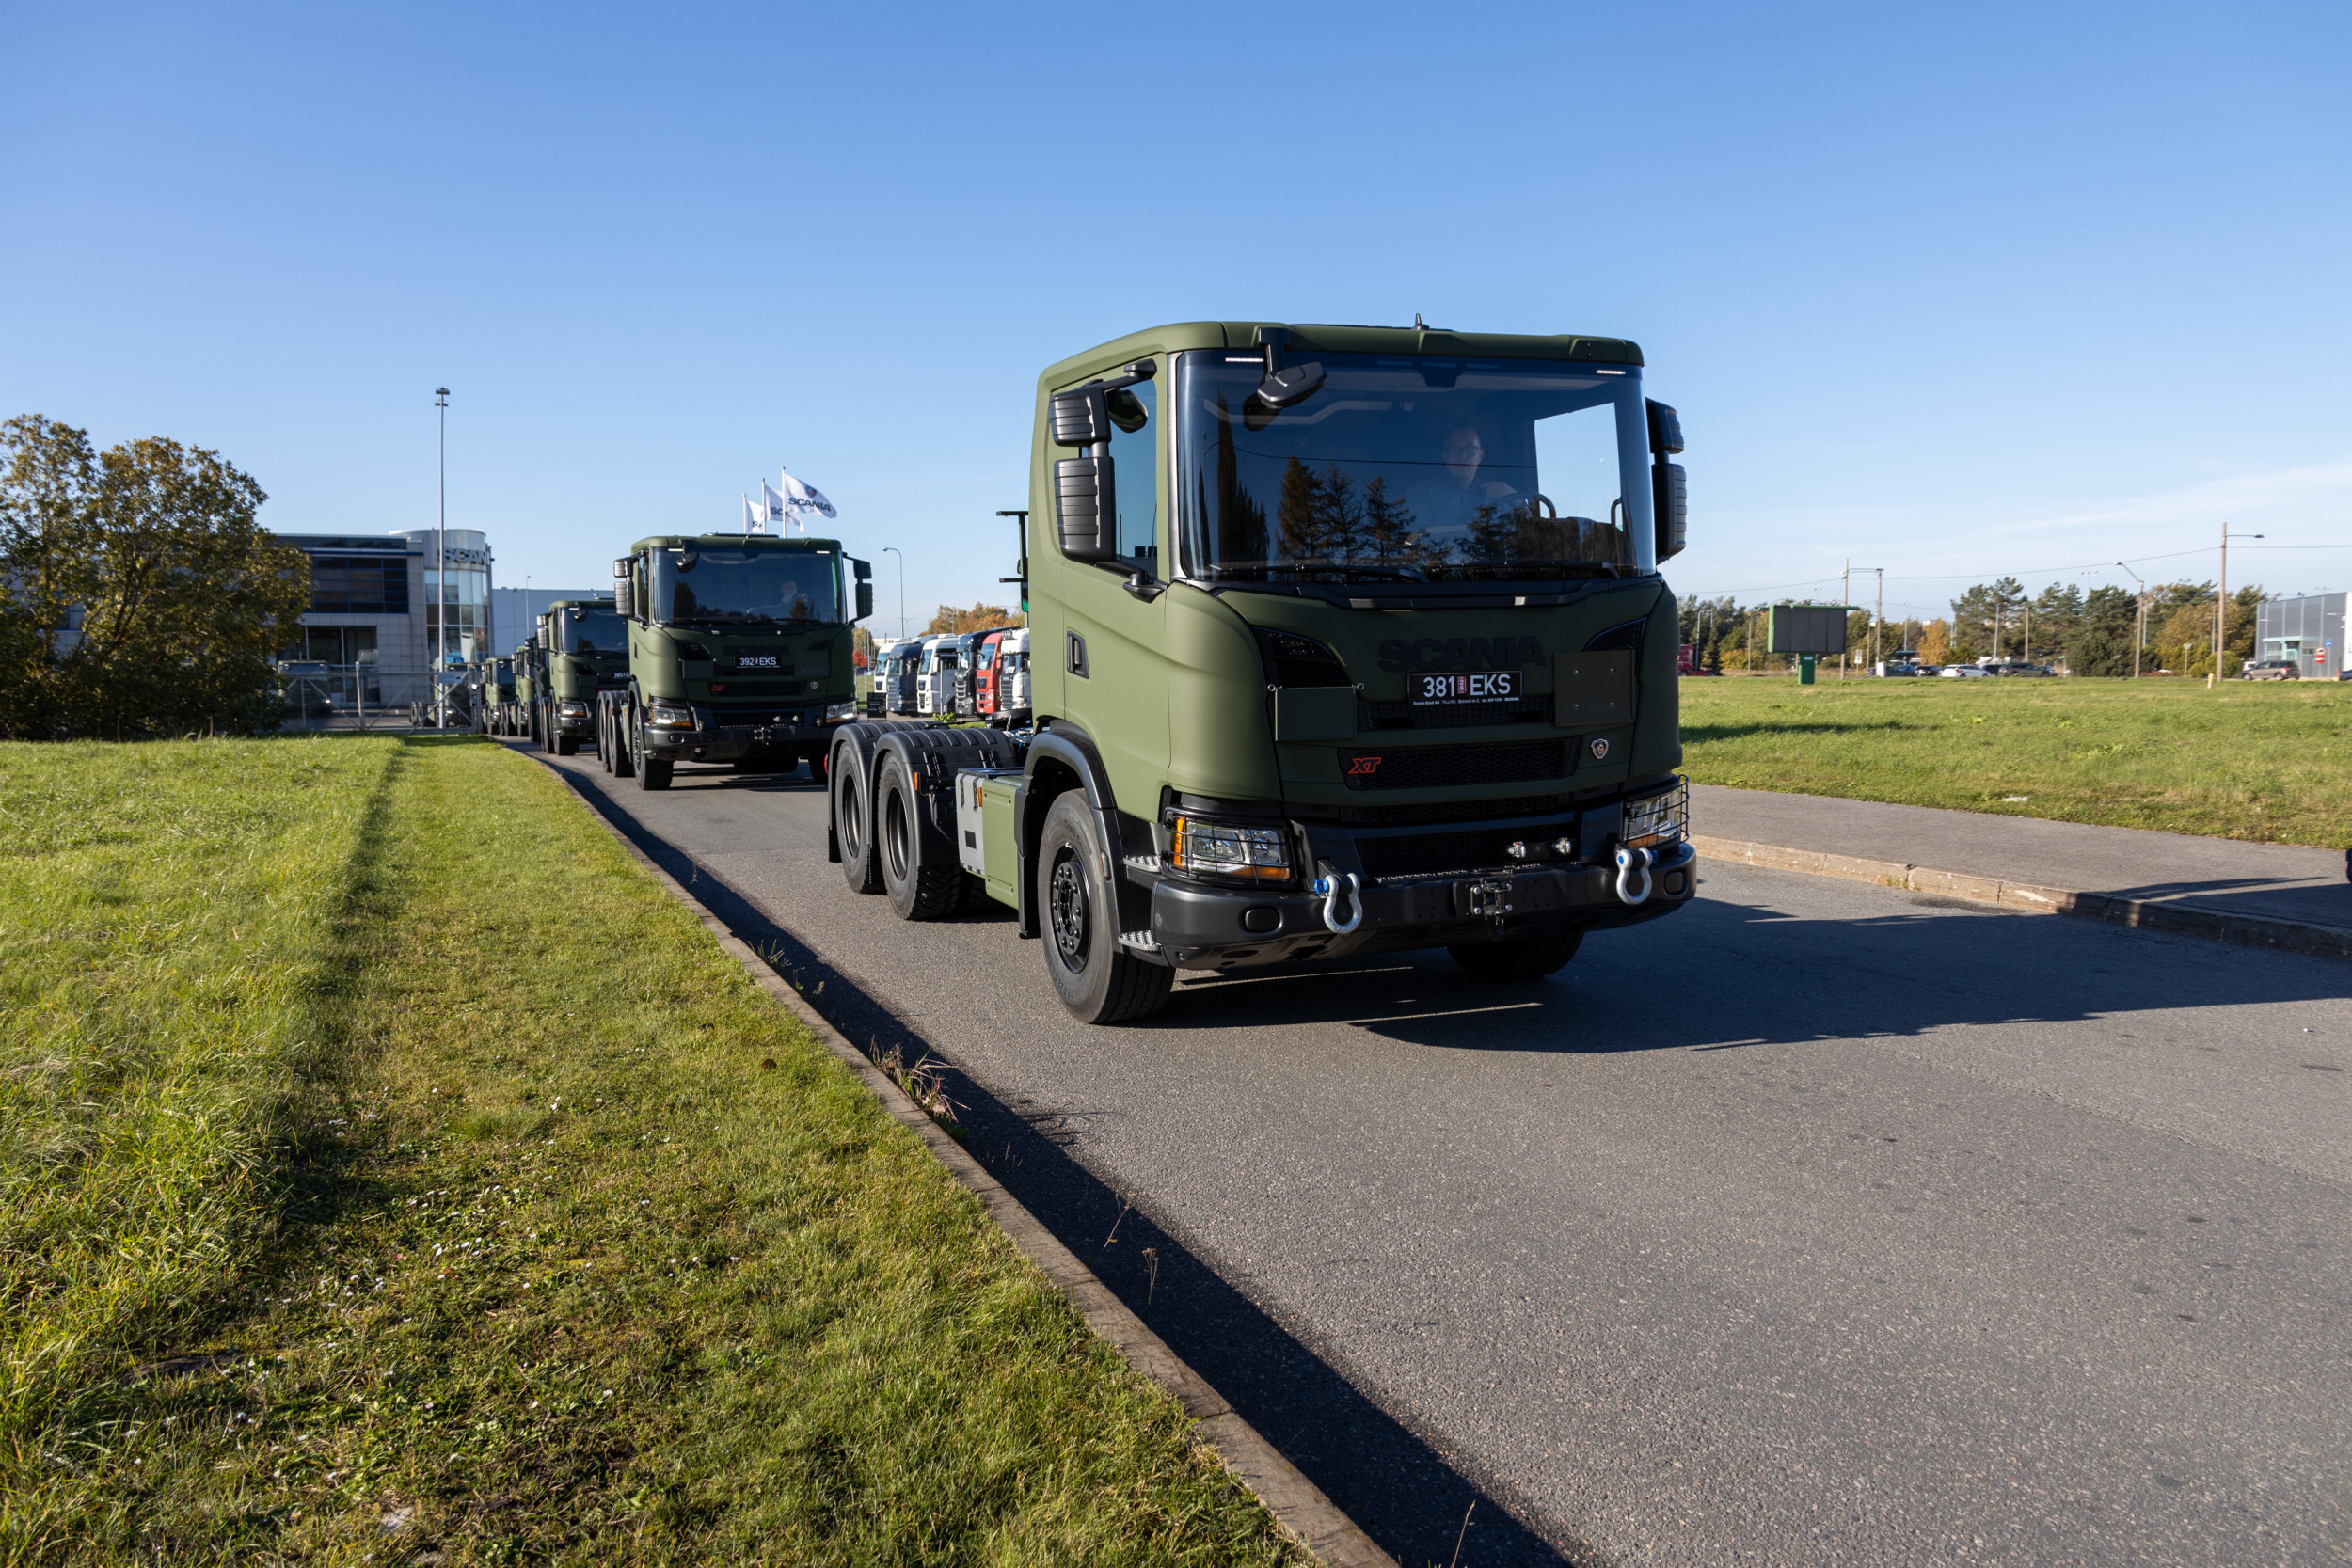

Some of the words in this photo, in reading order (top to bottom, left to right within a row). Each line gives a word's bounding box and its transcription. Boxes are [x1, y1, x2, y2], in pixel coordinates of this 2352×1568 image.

[787, 497, 832, 512] SCANIA
[739, 657, 755, 666] 392
[759, 657, 777, 666] EKS
[1378, 635, 1548, 673] SCANIA
[1423, 676, 1455, 697] 381
[1470, 673, 1511, 696] EKS
[1347, 756, 1381, 774] XT
